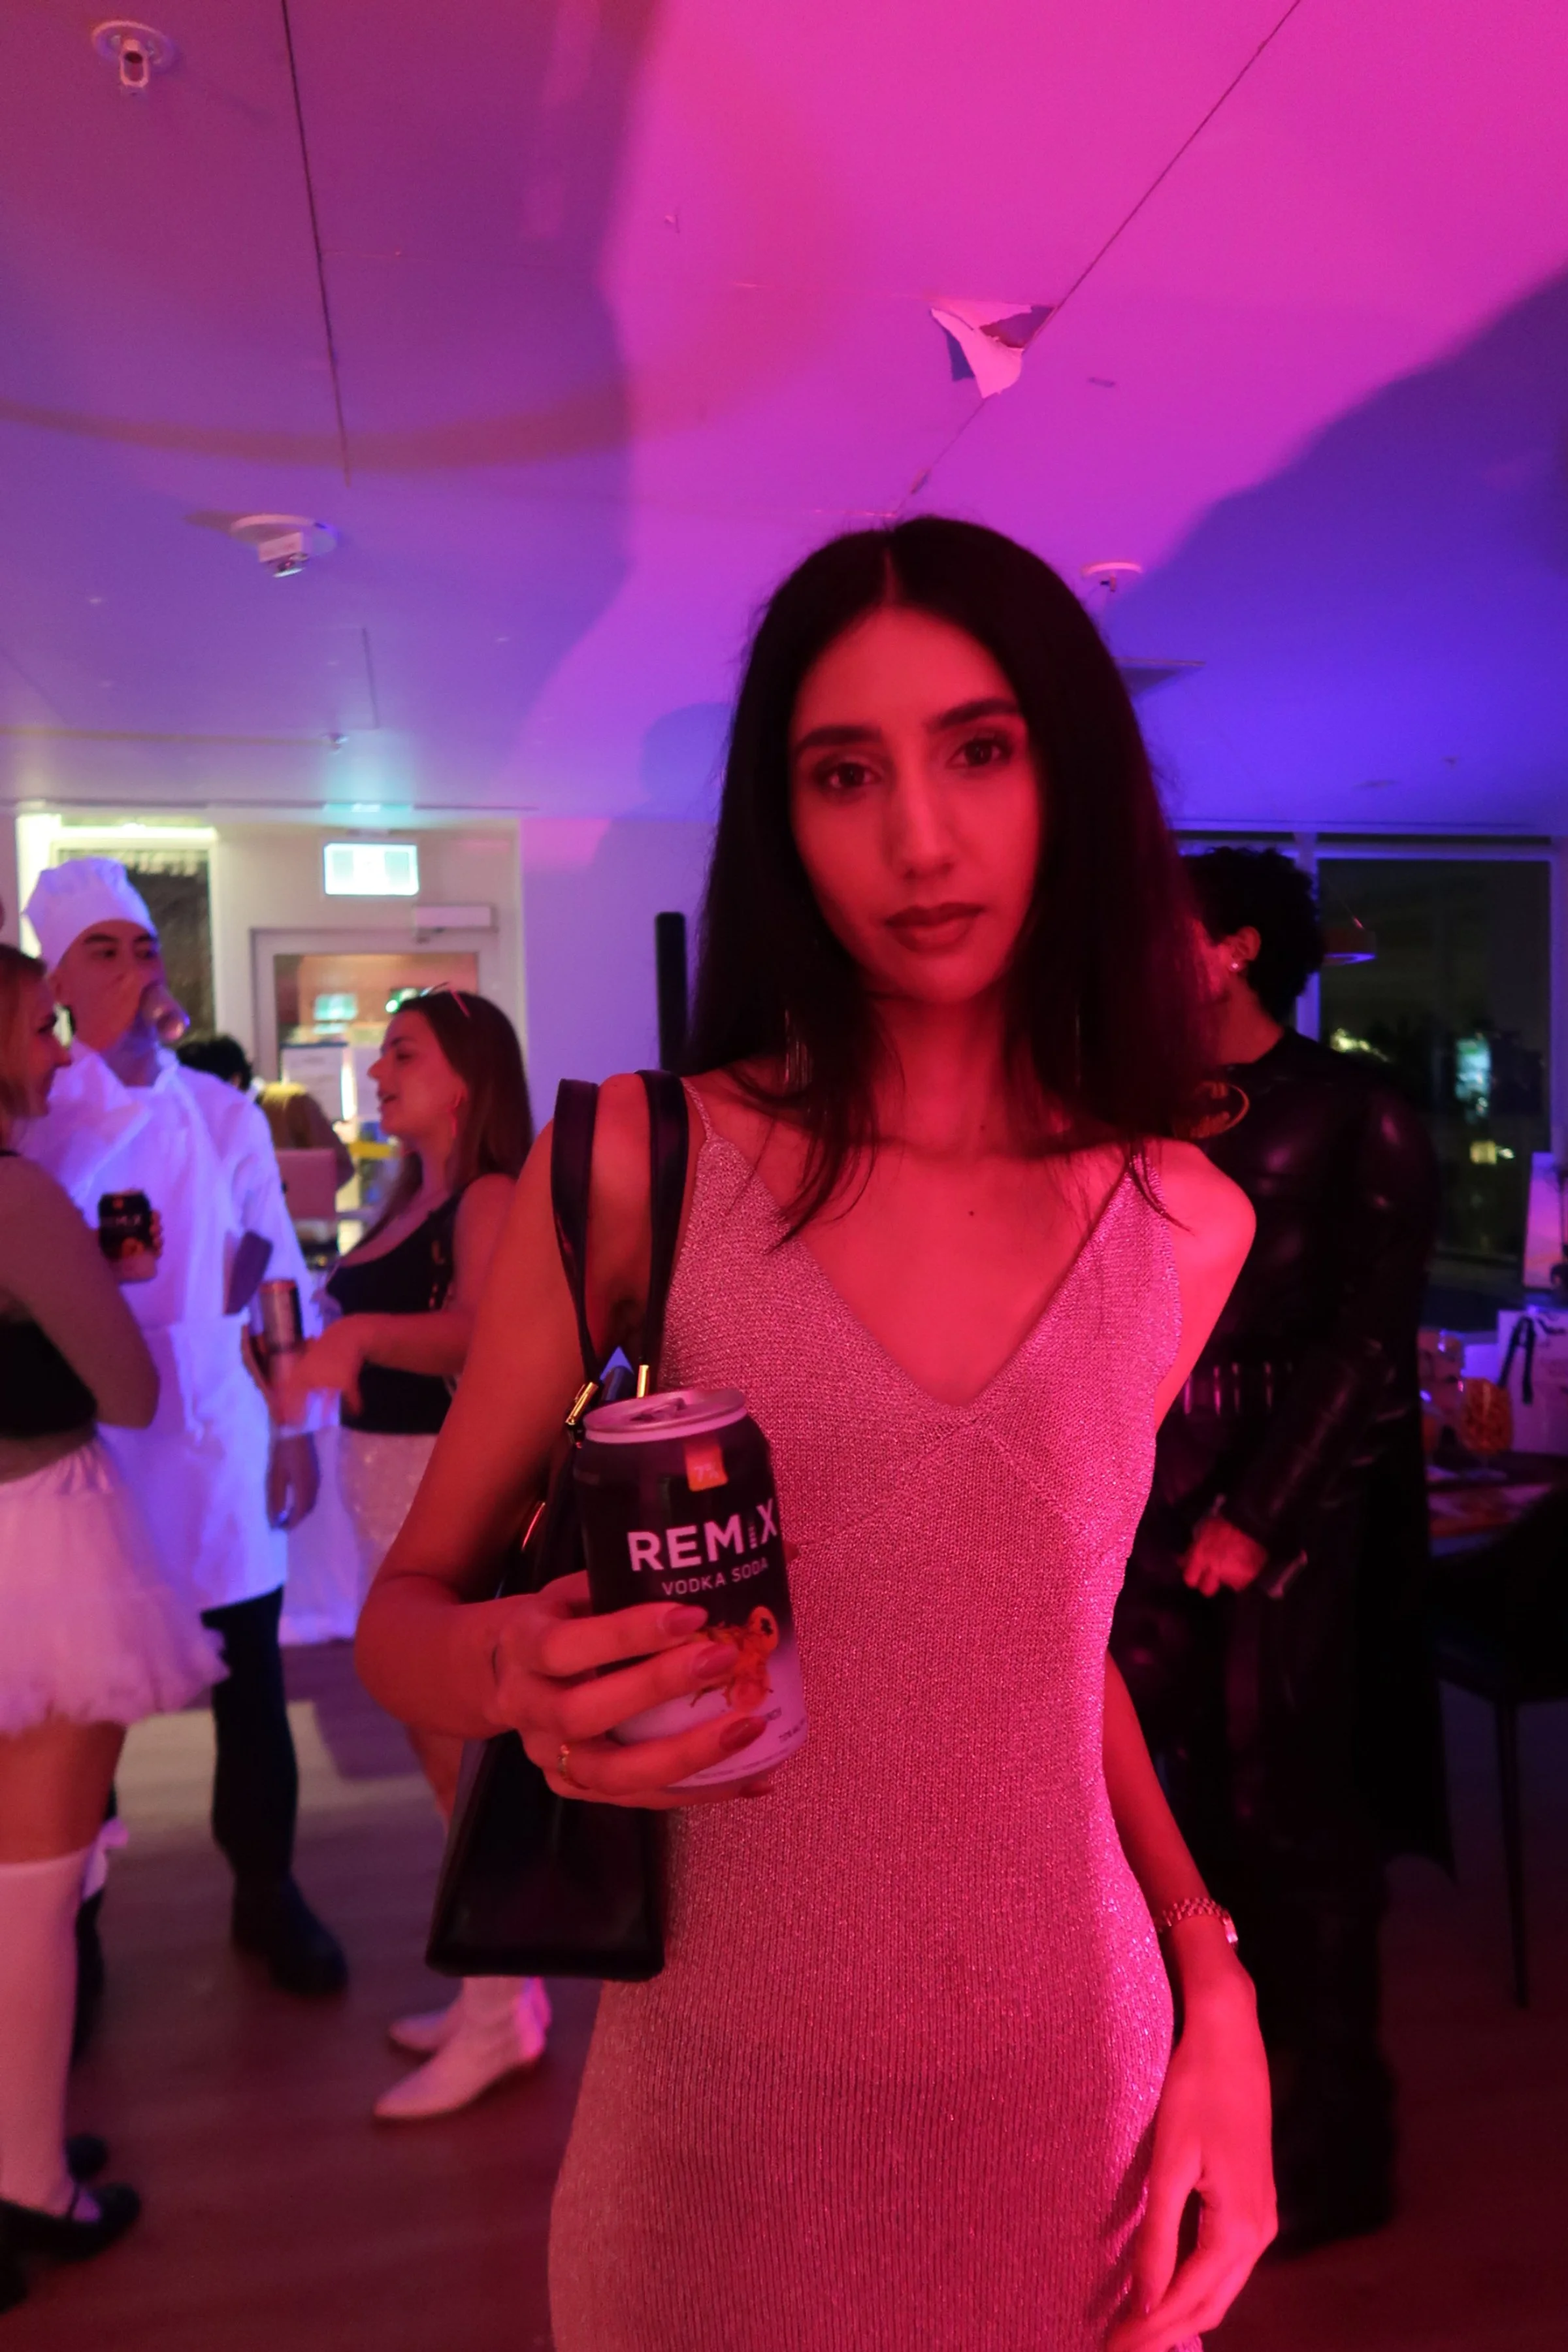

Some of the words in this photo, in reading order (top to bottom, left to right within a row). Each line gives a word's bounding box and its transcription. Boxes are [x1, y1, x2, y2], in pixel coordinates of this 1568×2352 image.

[627, 1498, 777, 1572] REMIX
[661, 1572, 727, 1596] VODKA
[731, 1557, 769, 1583] SODA
